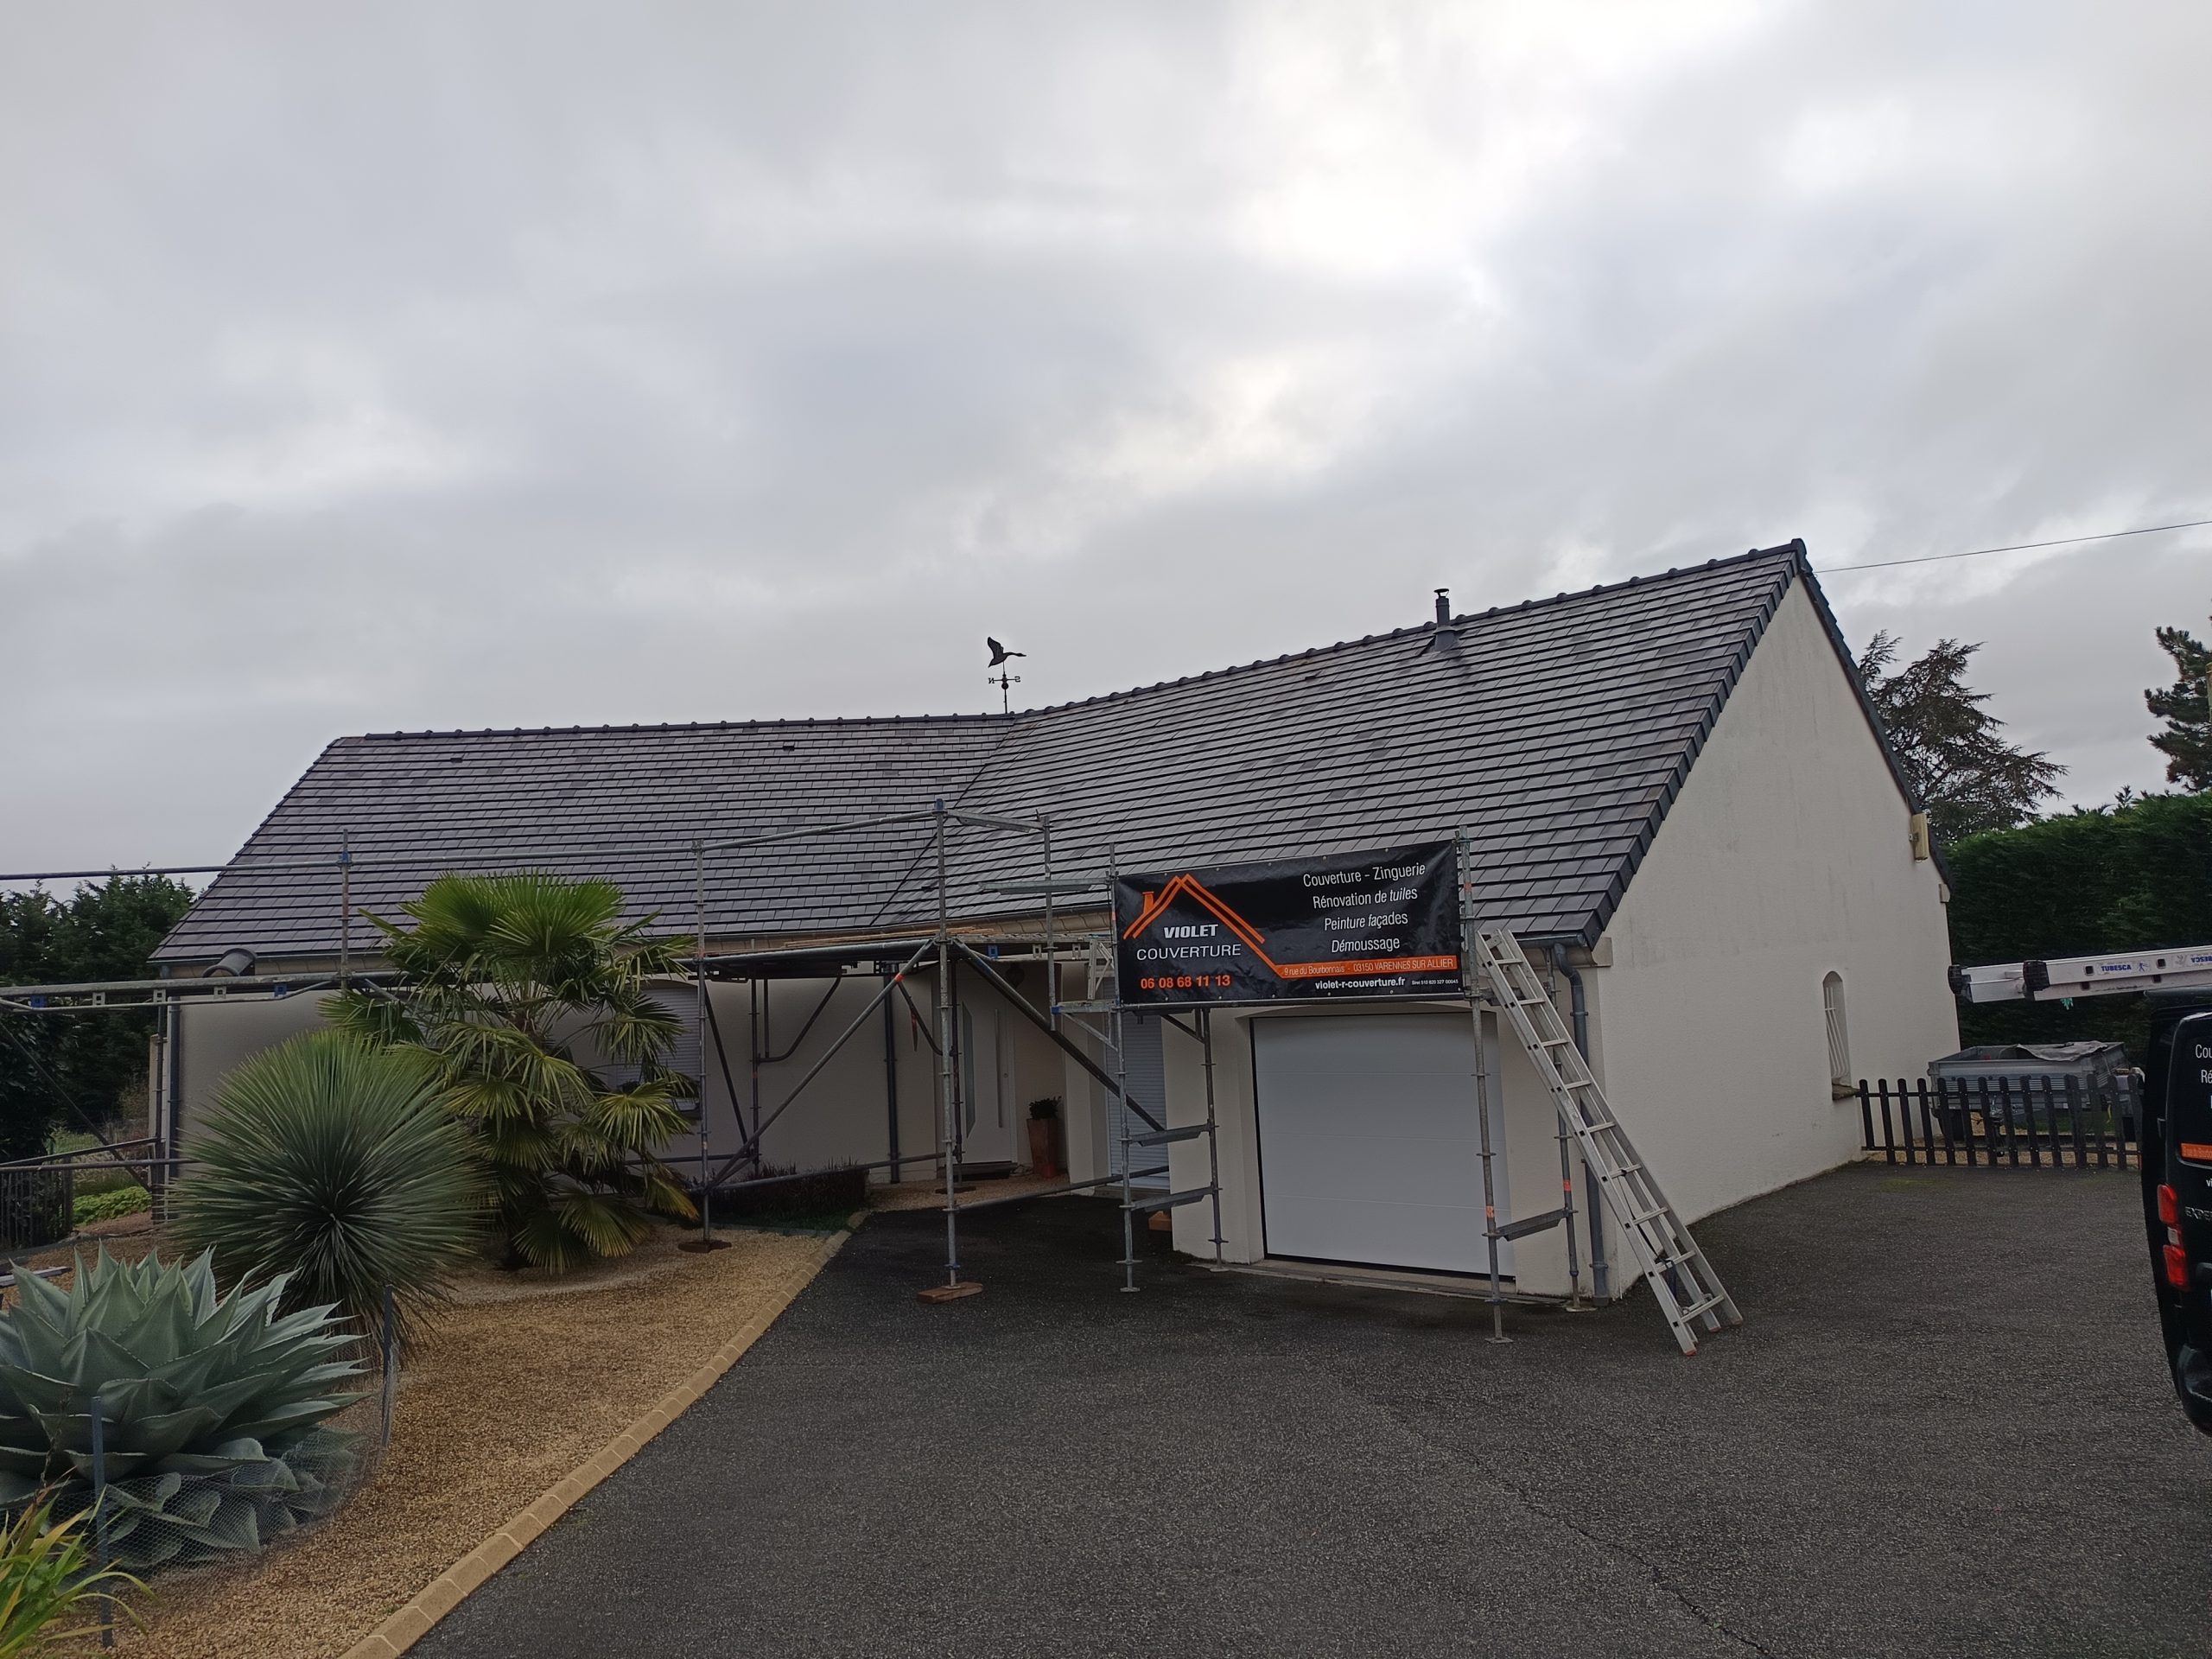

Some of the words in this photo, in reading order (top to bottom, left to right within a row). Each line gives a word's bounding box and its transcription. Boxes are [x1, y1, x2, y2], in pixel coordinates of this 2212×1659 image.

[1303, 871, 1362, 887] Couverture
[1372, 862, 1426, 881] Zinguerie
[1313, 893, 1371, 909] Rénovation
[1374, 890, 1387, 904] de
[1389, 887, 1418, 902] tuiles
[1324, 917, 1365, 931] Peinture
[1368, 911, 1408, 929] façades
[1164, 924, 1218, 938] VIOLET
[1136, 944, 1242, 961] COUVERTURE
[1332, 938, 1400, 953] Démoussage
[1300, 966, 1306, 975] du
[1308, 964, 1345, 975] Bourbonnais
[1353, 963, 1373, 971] 03150
[1374, 960, 1410, 970] VARENNES
[1412, 959, 1426, 969] SUR
[1427, 958, 1453, 968] ALLIER
[1141, 978, 1154, 989] 06
[1159, 977, 1173, 988] 08
[1177, 976, 1192, 988] 68
[1196, 975, 1210, 987] 11
[1215, 975, 1230, 987] 13
[1315, 976, 1406, 989] violet-r-couverture.fr
[2184, 1206, 2212, 1221] EXPE
